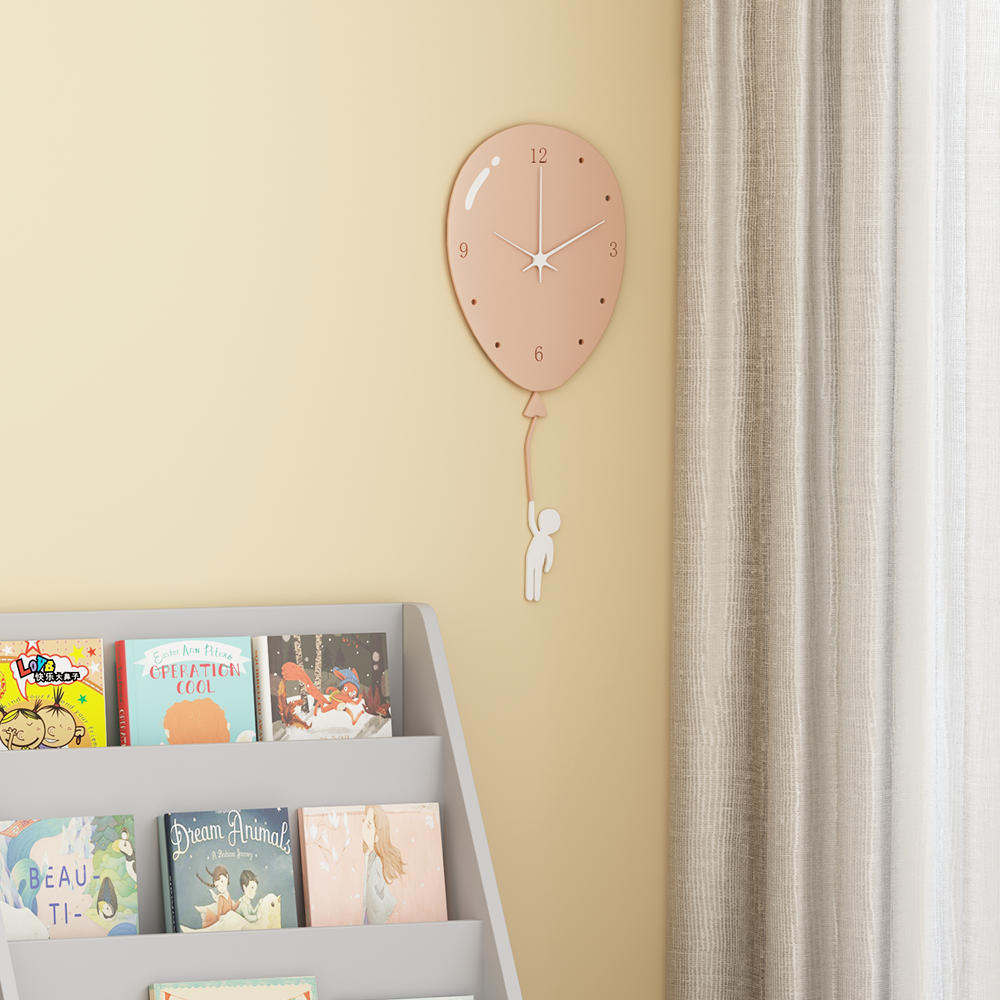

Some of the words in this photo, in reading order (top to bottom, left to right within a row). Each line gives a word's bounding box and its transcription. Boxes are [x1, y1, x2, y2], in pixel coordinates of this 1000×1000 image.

[530, 147, 548, 164] 12
[459, 242, 469, 259] 9
[609, 241, 618, 258] 3
[534, 345, 544, 362] 6
[34, 672, 80, 682] 快乐大鼻子
[149, 662, 241, 680] OPERATION
[176, 679, 216, 695] COOL
[170, 818, 225, 861] Dream
[227, 809, 291, 855] Animals
[29, 864, 100, 890] BEAU-
[48, 902, 82, 925] TI-
